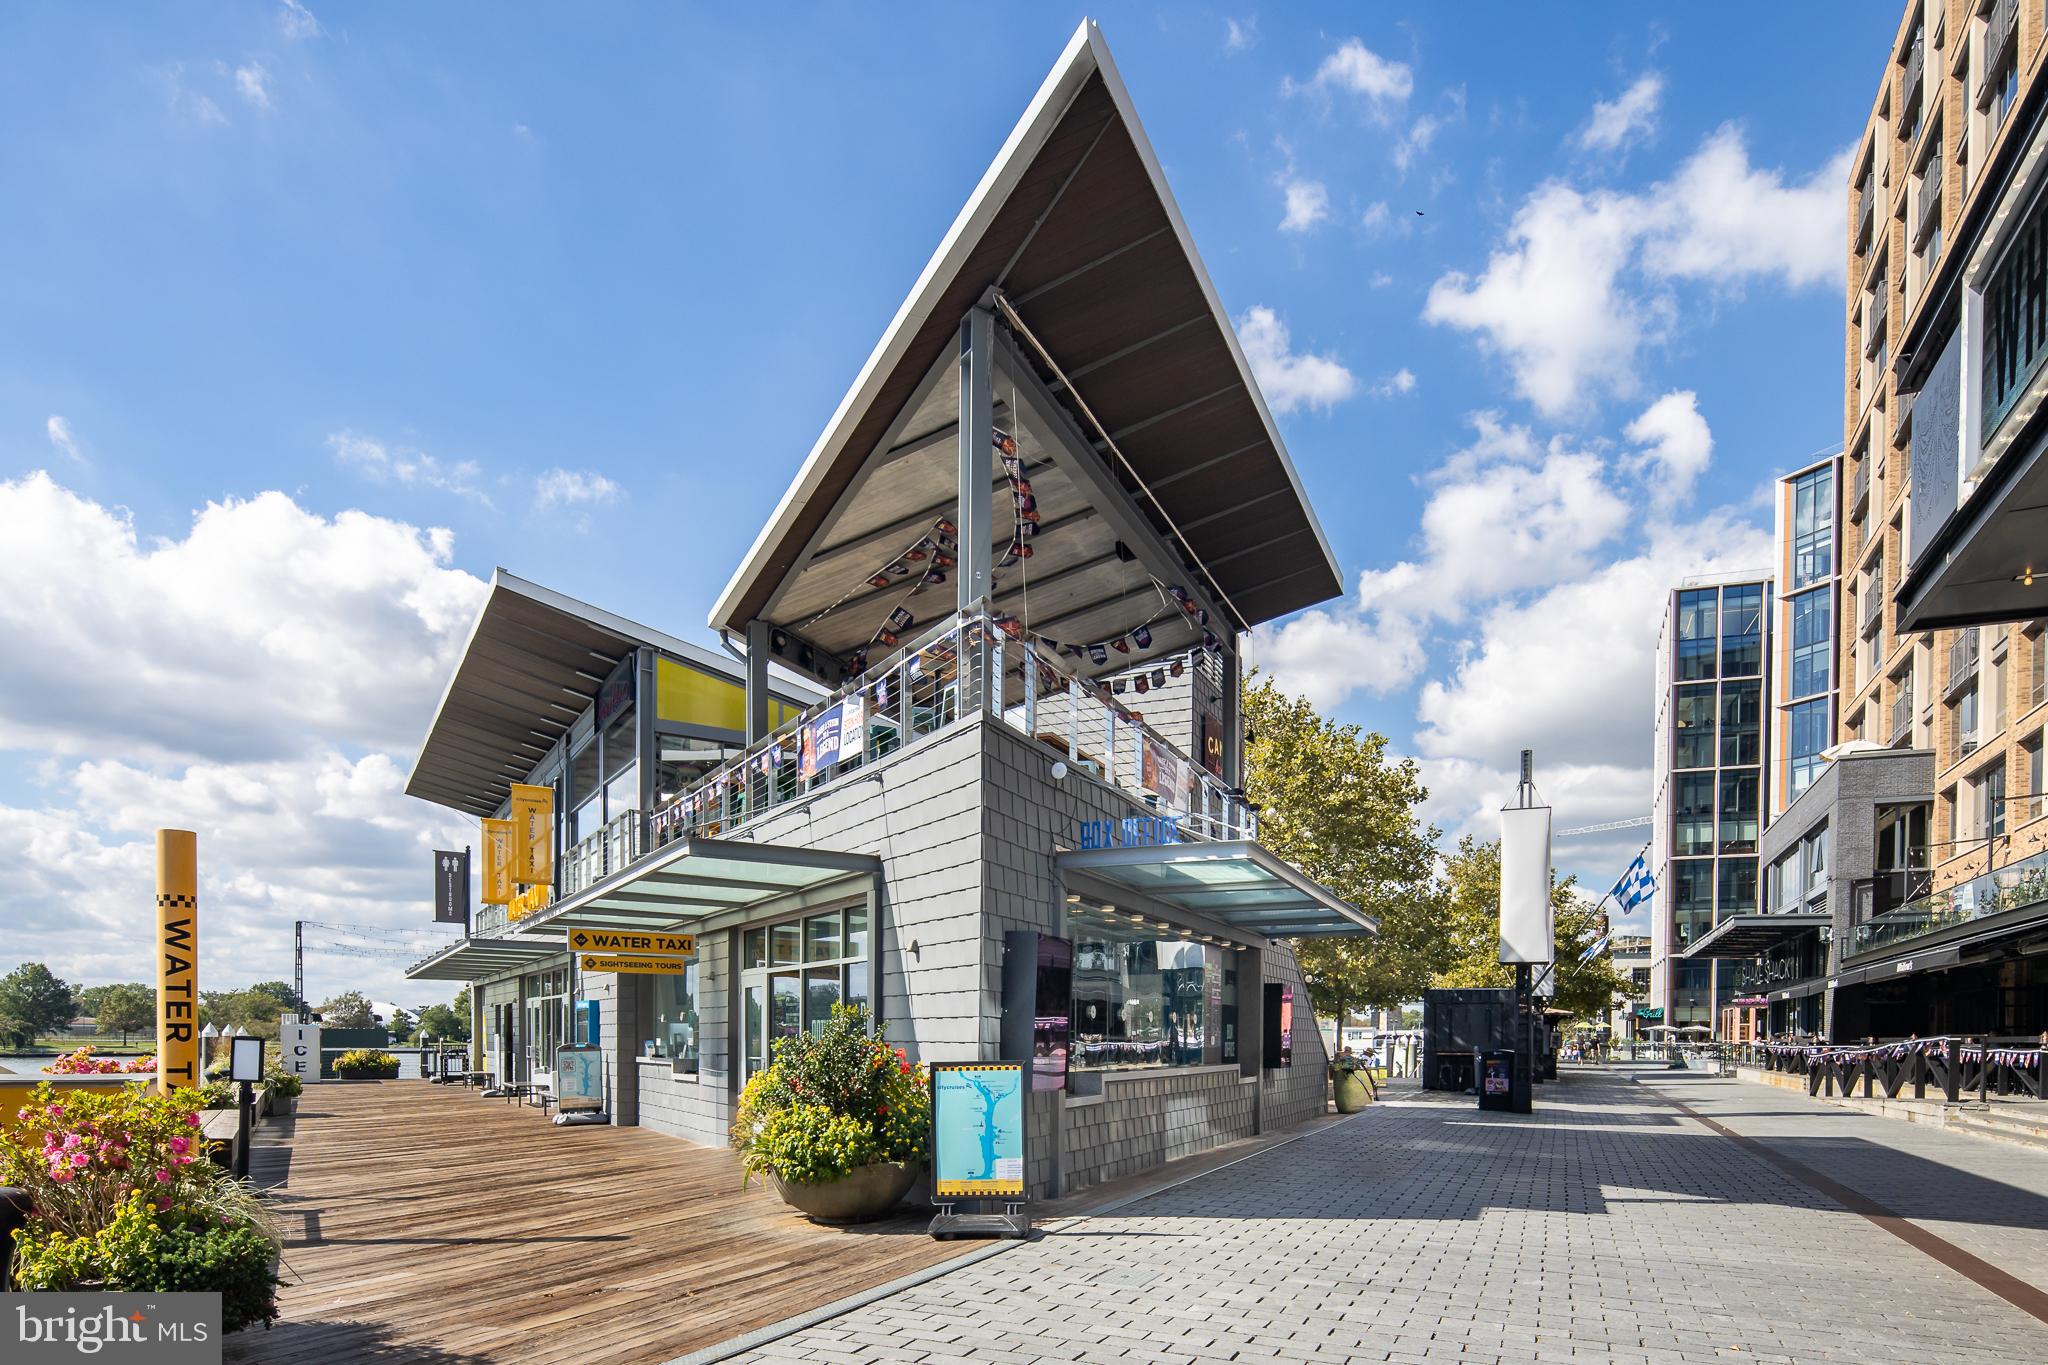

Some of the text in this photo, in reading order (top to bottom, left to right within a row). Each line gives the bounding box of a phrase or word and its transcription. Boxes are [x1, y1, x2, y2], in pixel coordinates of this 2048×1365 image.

[528, 807, 536, 840] WATER
[1080, 815, 1184, 849] BOX OFFICE
[592, 934, 691, 951] WATER TAXI
[600, 960, 682, 970] SIGHTSEEING TOURS
[1742, 958, 1790, 986] SHAKE SHACK
[164, 918, 192, 1043] WATER
[1643, 1007, 1665, 1020] Grill
[293, 1029, 308, 1073] ICE
